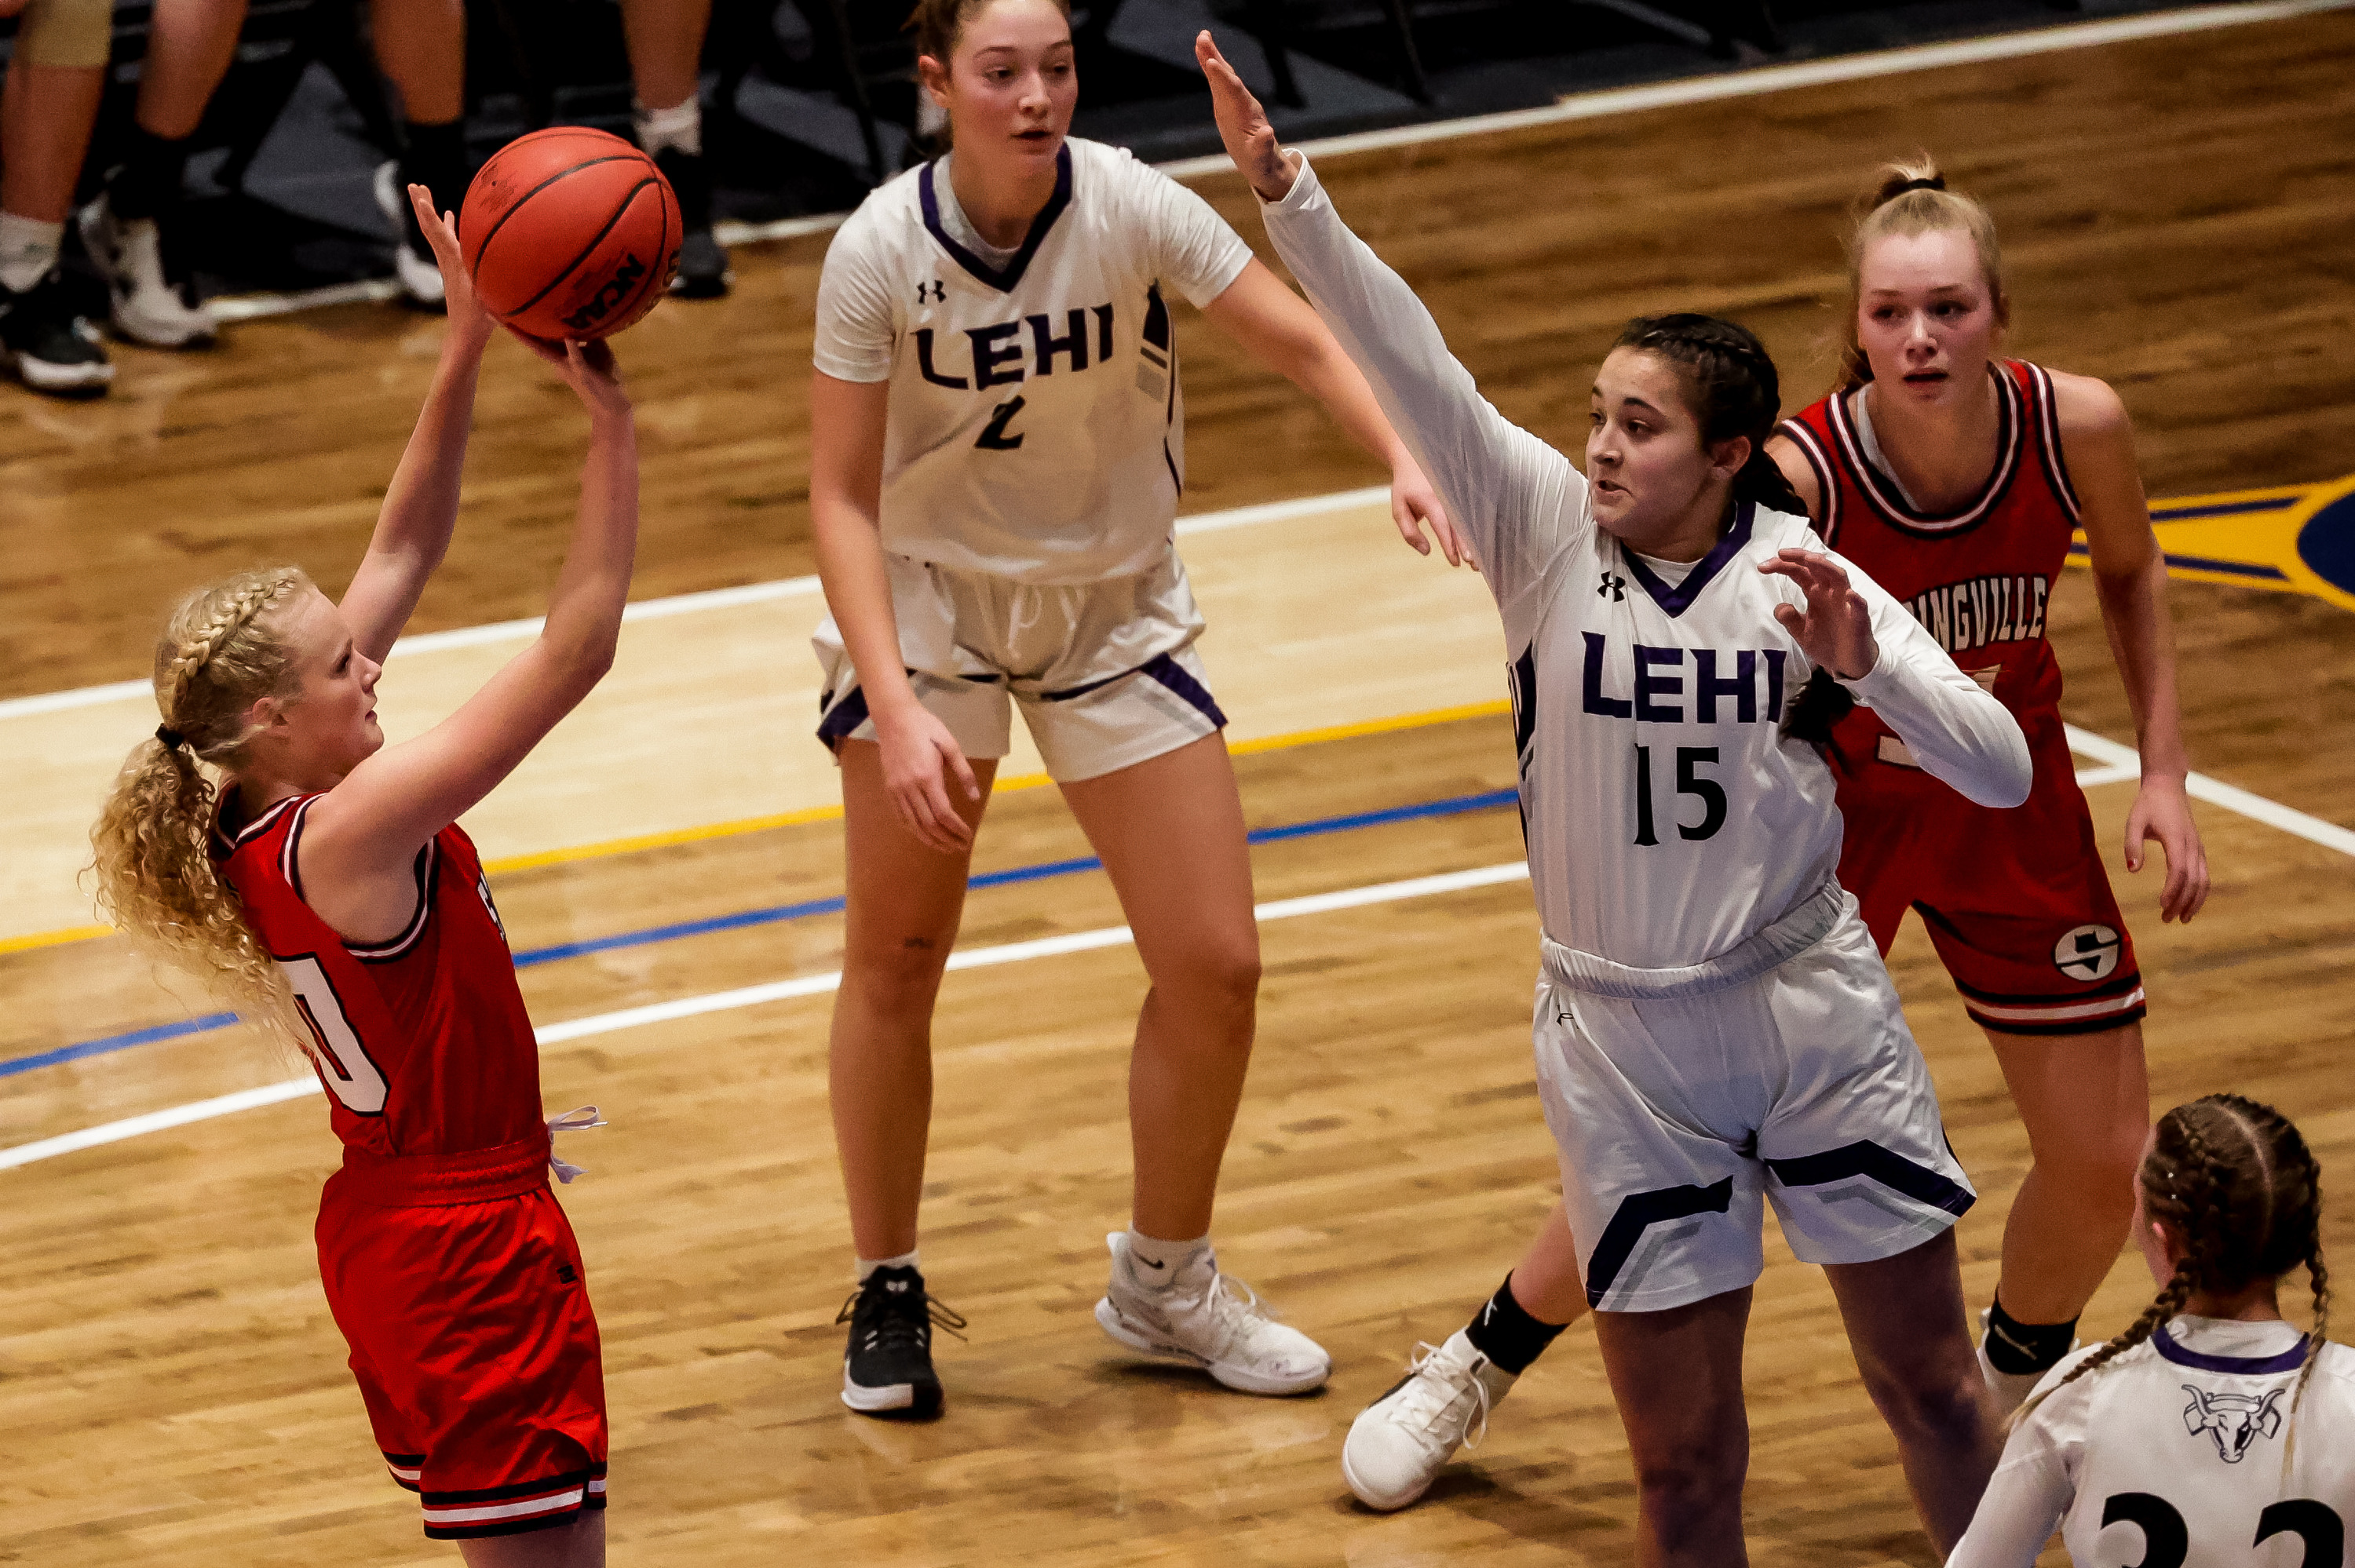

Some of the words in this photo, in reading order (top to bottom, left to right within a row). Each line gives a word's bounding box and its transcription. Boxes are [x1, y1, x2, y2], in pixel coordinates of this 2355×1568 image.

[909, 301, 1113, 391] LEHI
[975, 395, 1025, 449] 2
[1580, 630, 1787, 724] LEHI
[1633, 742, 1728, 846] 15
